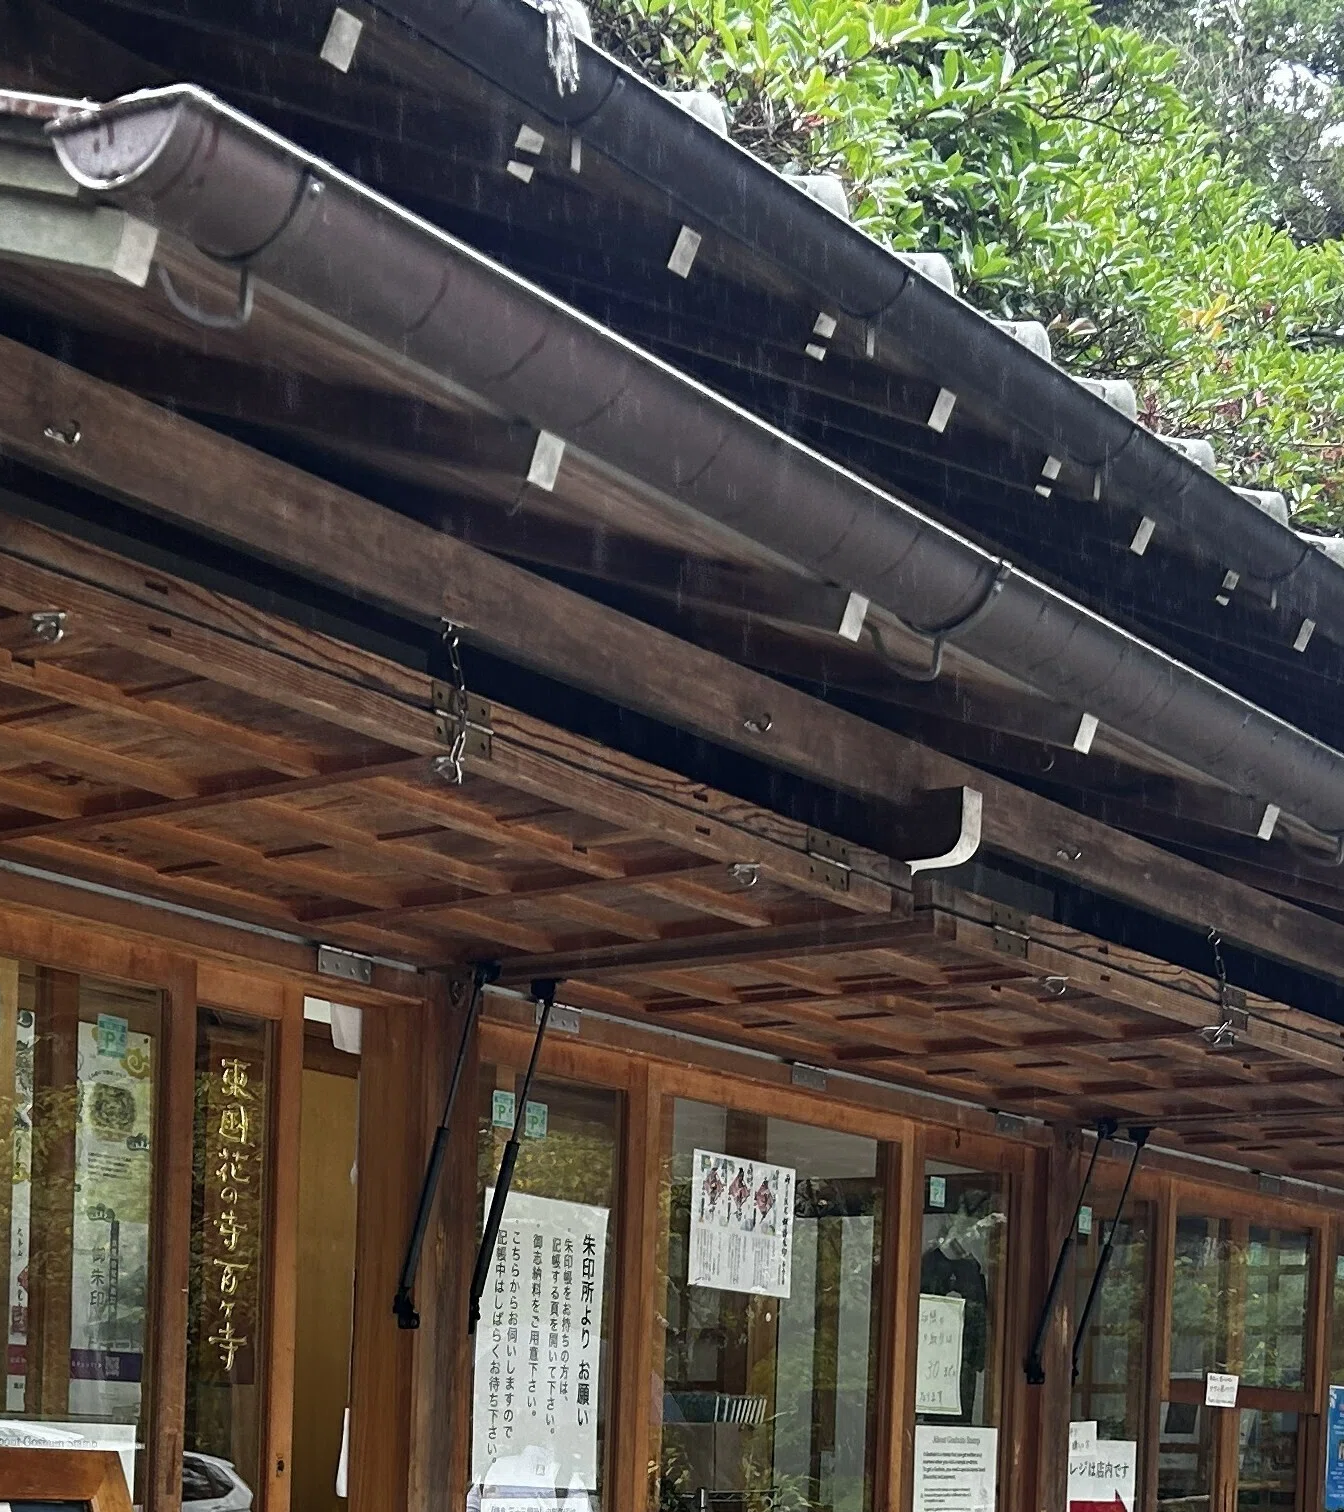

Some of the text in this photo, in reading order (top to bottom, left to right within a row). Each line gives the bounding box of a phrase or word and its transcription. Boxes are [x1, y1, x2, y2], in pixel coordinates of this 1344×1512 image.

[577, 1234, 596, 1427] 朱印所より お願い
[1069, 1461, 1130, 1479] レジは店内です
